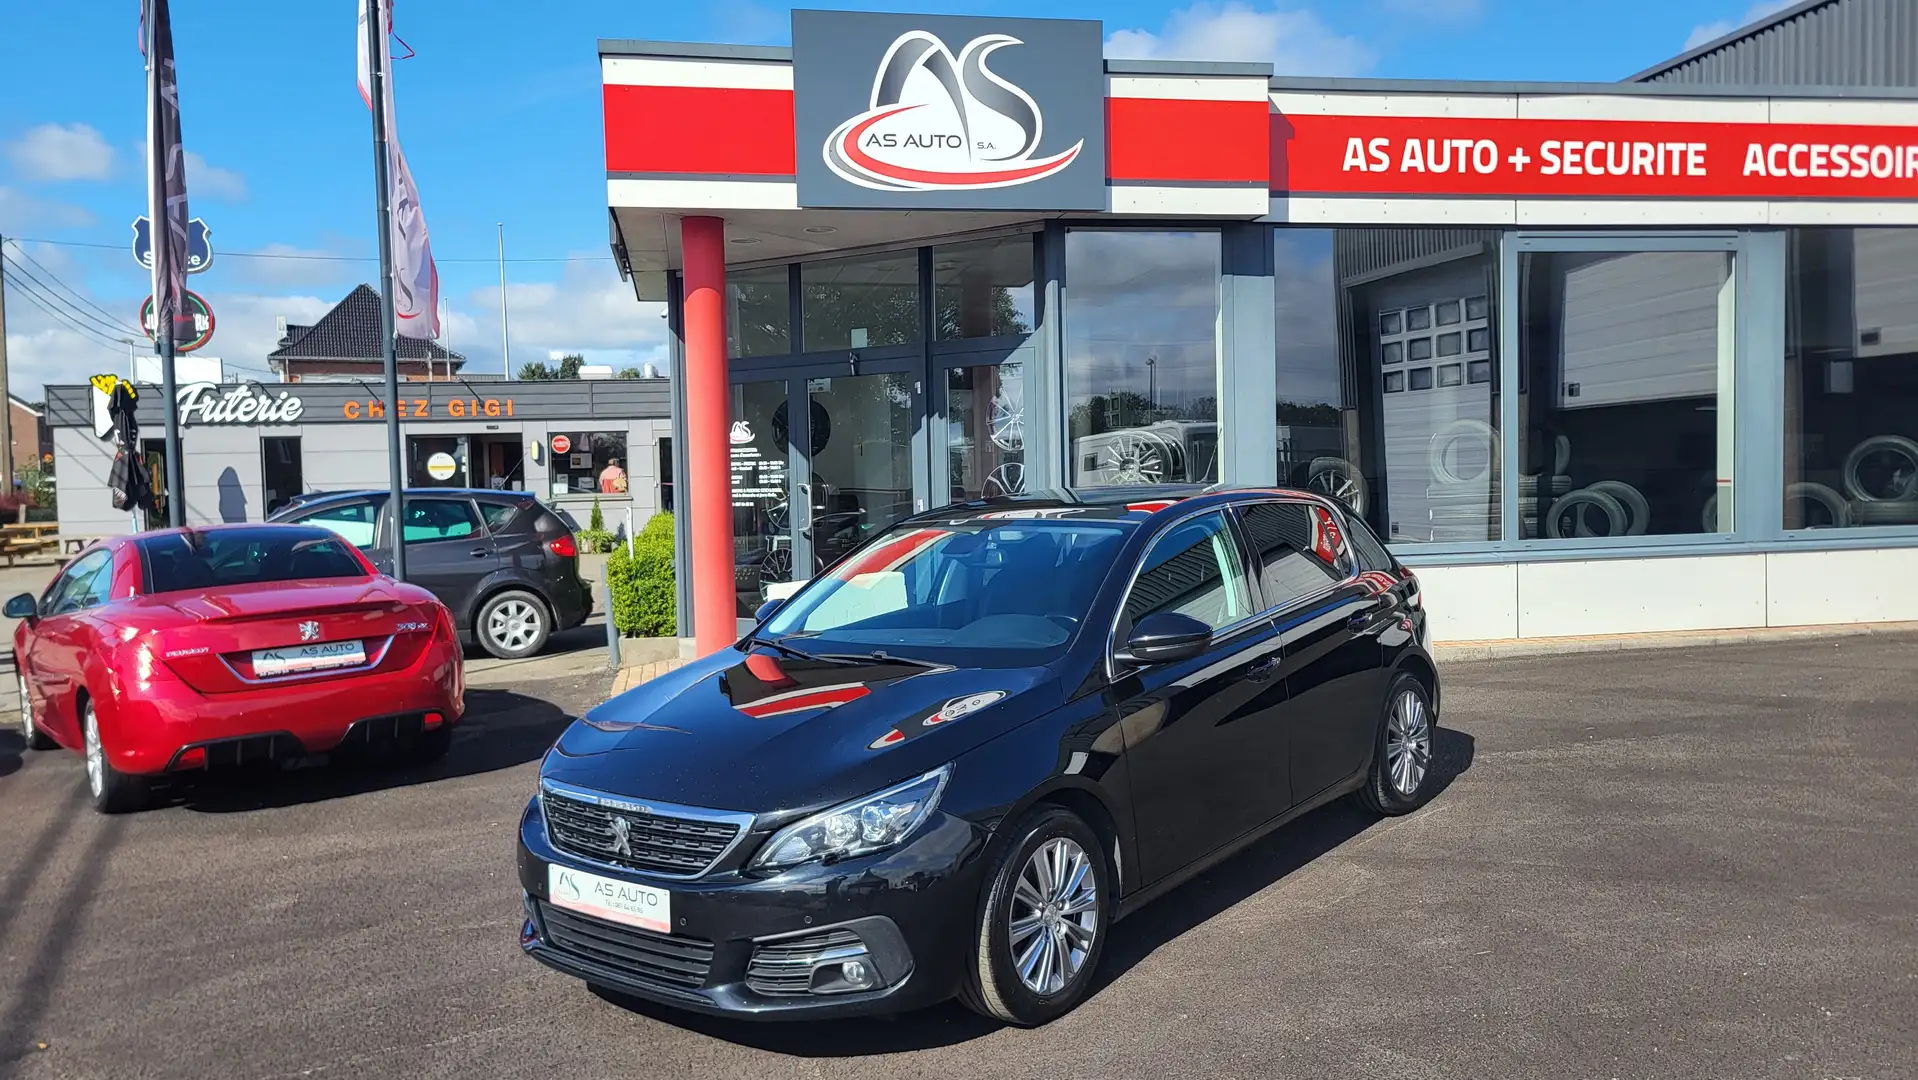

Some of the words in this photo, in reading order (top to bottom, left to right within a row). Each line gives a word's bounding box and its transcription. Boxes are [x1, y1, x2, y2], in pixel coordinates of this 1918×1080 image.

[865, 133, 897, 148] AS
[903, 134, 962, 149] AUTO
[976, 141, 997, 150] S.A.
[1342, 137, 1391, 173] AS
[1400, 138, 1498, 175] AUTO
[1508, 146, 1531, 173] +
[1540, 140, 1707, 177] SECURITE
[175, 382, 304, 425] Friterie
[344, 399, 428, 419] CHEZ
[448, 399, 514, 418] GIGI
[300, 646, 319, 657] AS
[321, 642, 355, 655] AUTO
[594, 881, 614, 898] AS
[617, 886, 659, 907] AUTO
